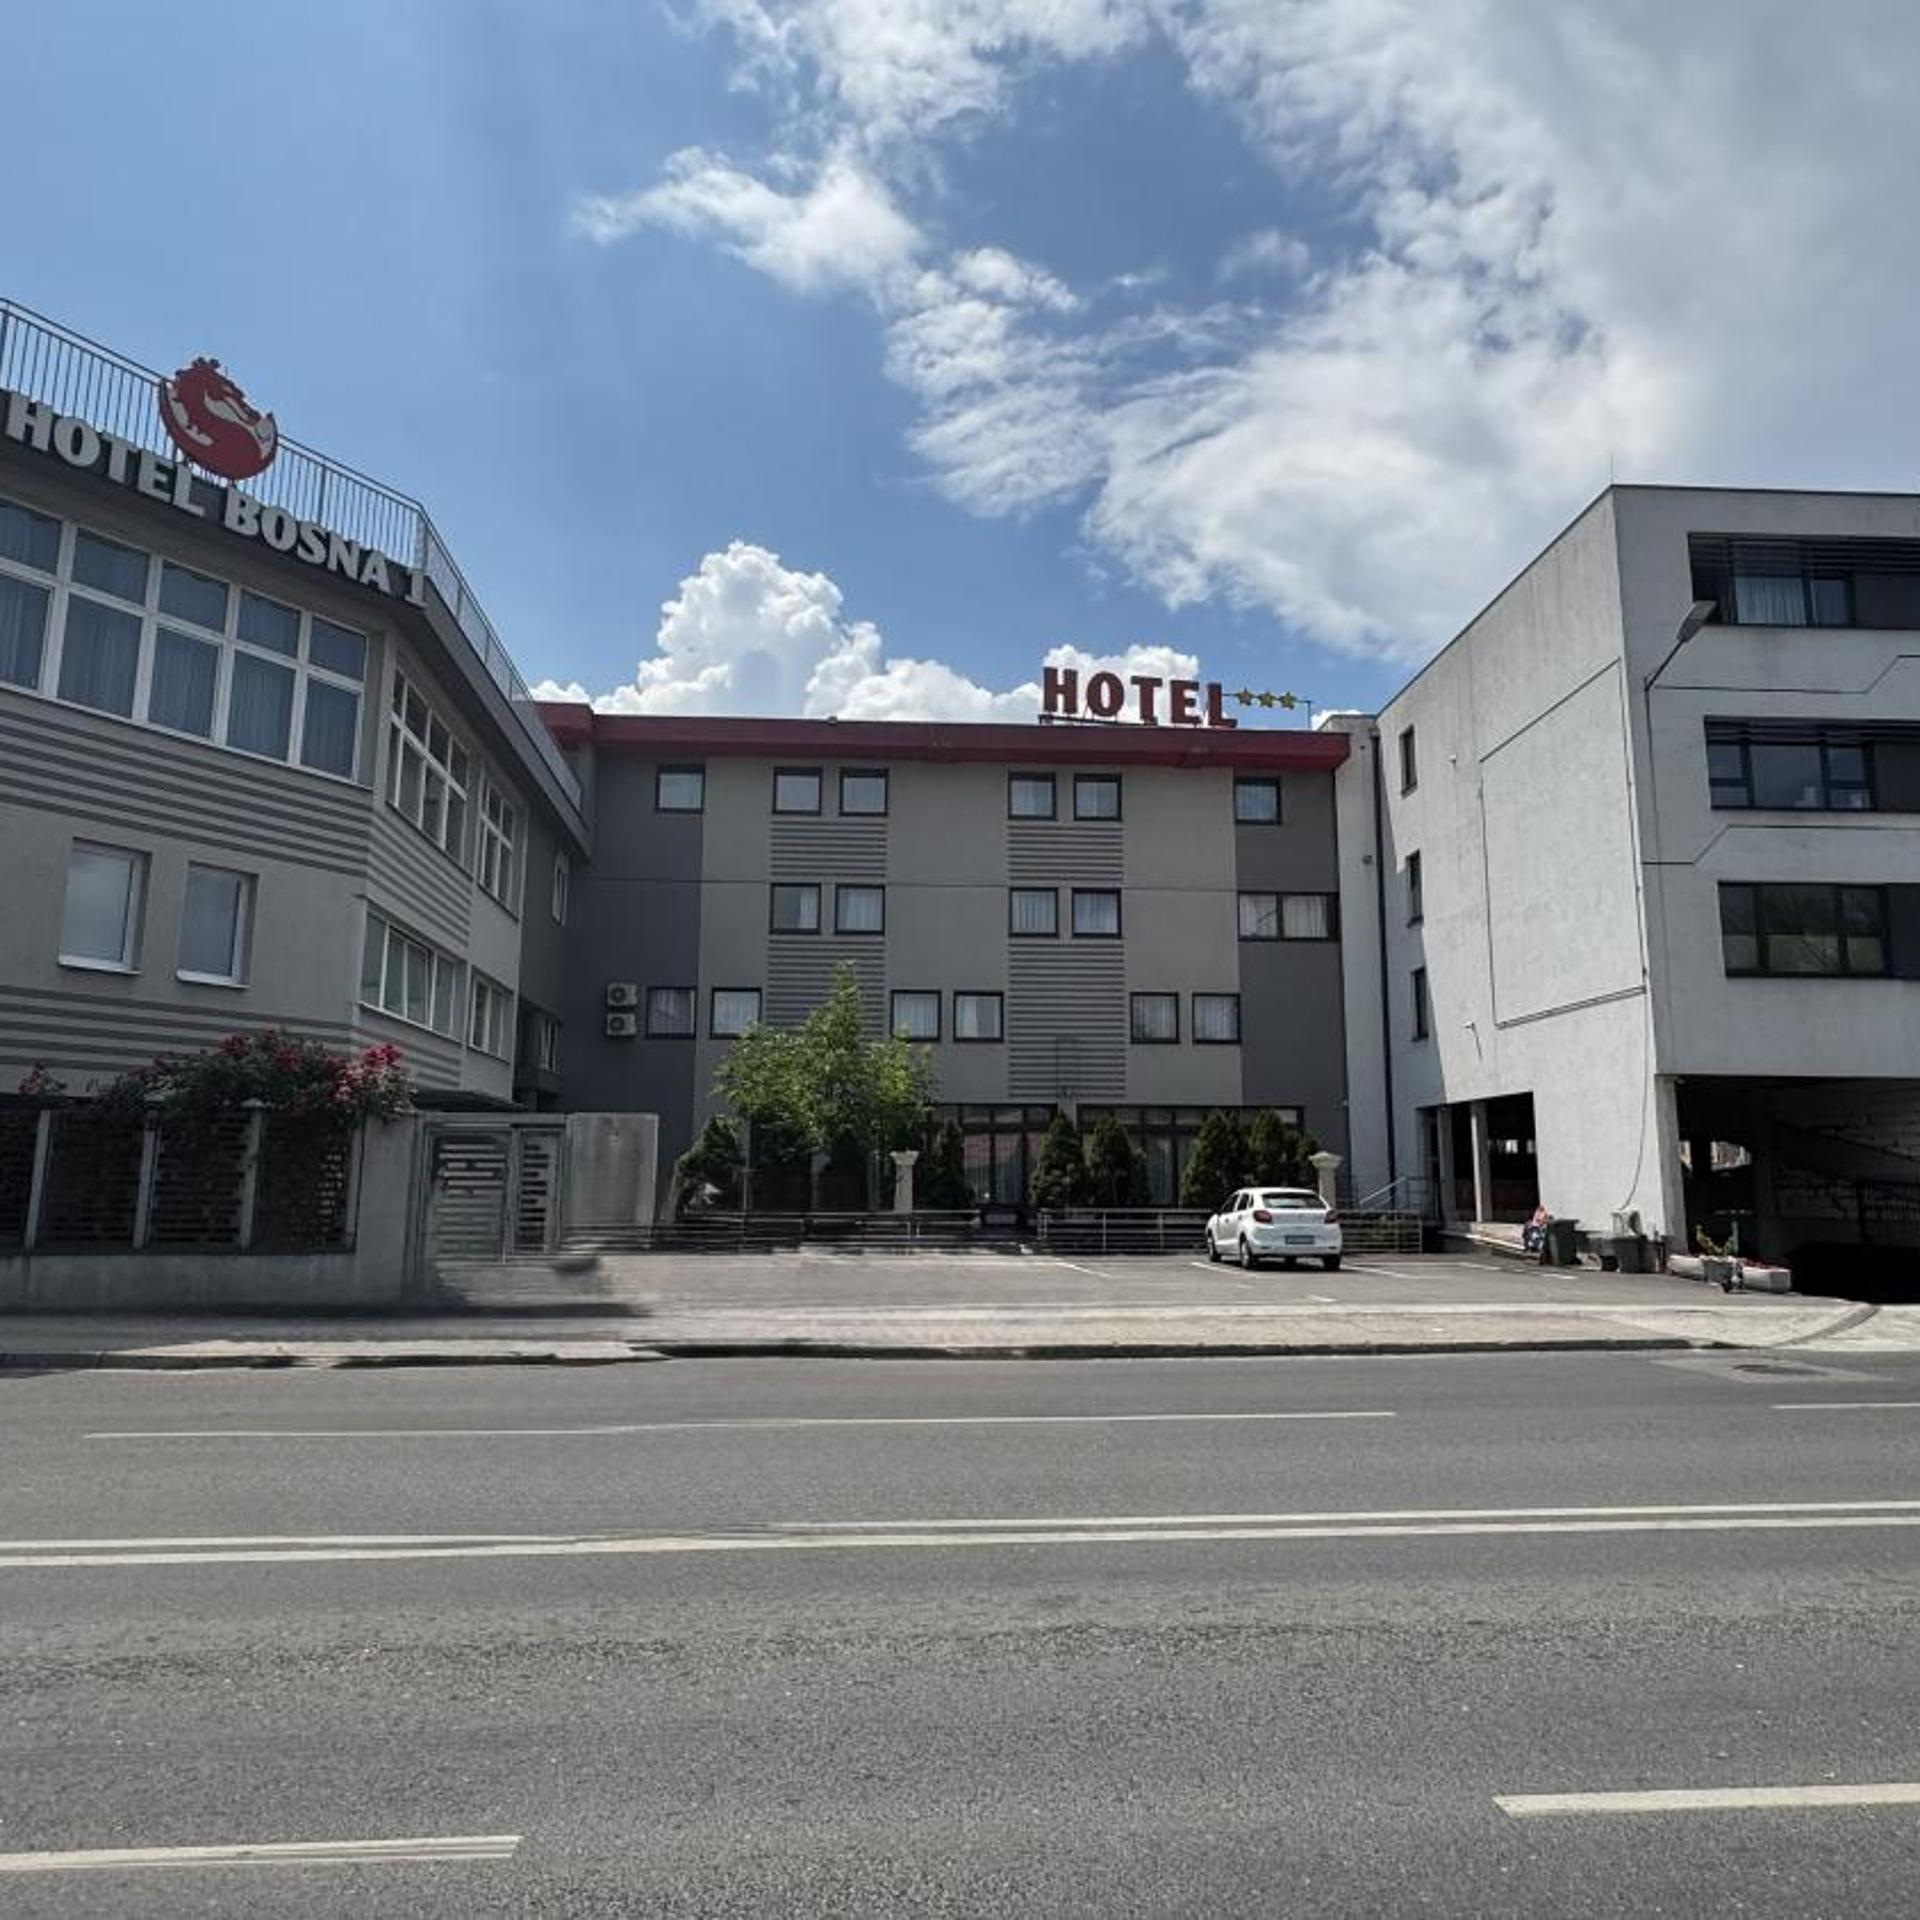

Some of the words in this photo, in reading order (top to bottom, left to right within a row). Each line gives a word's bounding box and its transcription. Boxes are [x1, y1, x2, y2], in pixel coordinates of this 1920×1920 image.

[4, 391, 205, 517] HOTEL
[223, 485, 393, 596] BOSNA
[1043, 667, 1238, 728] HOTEL
